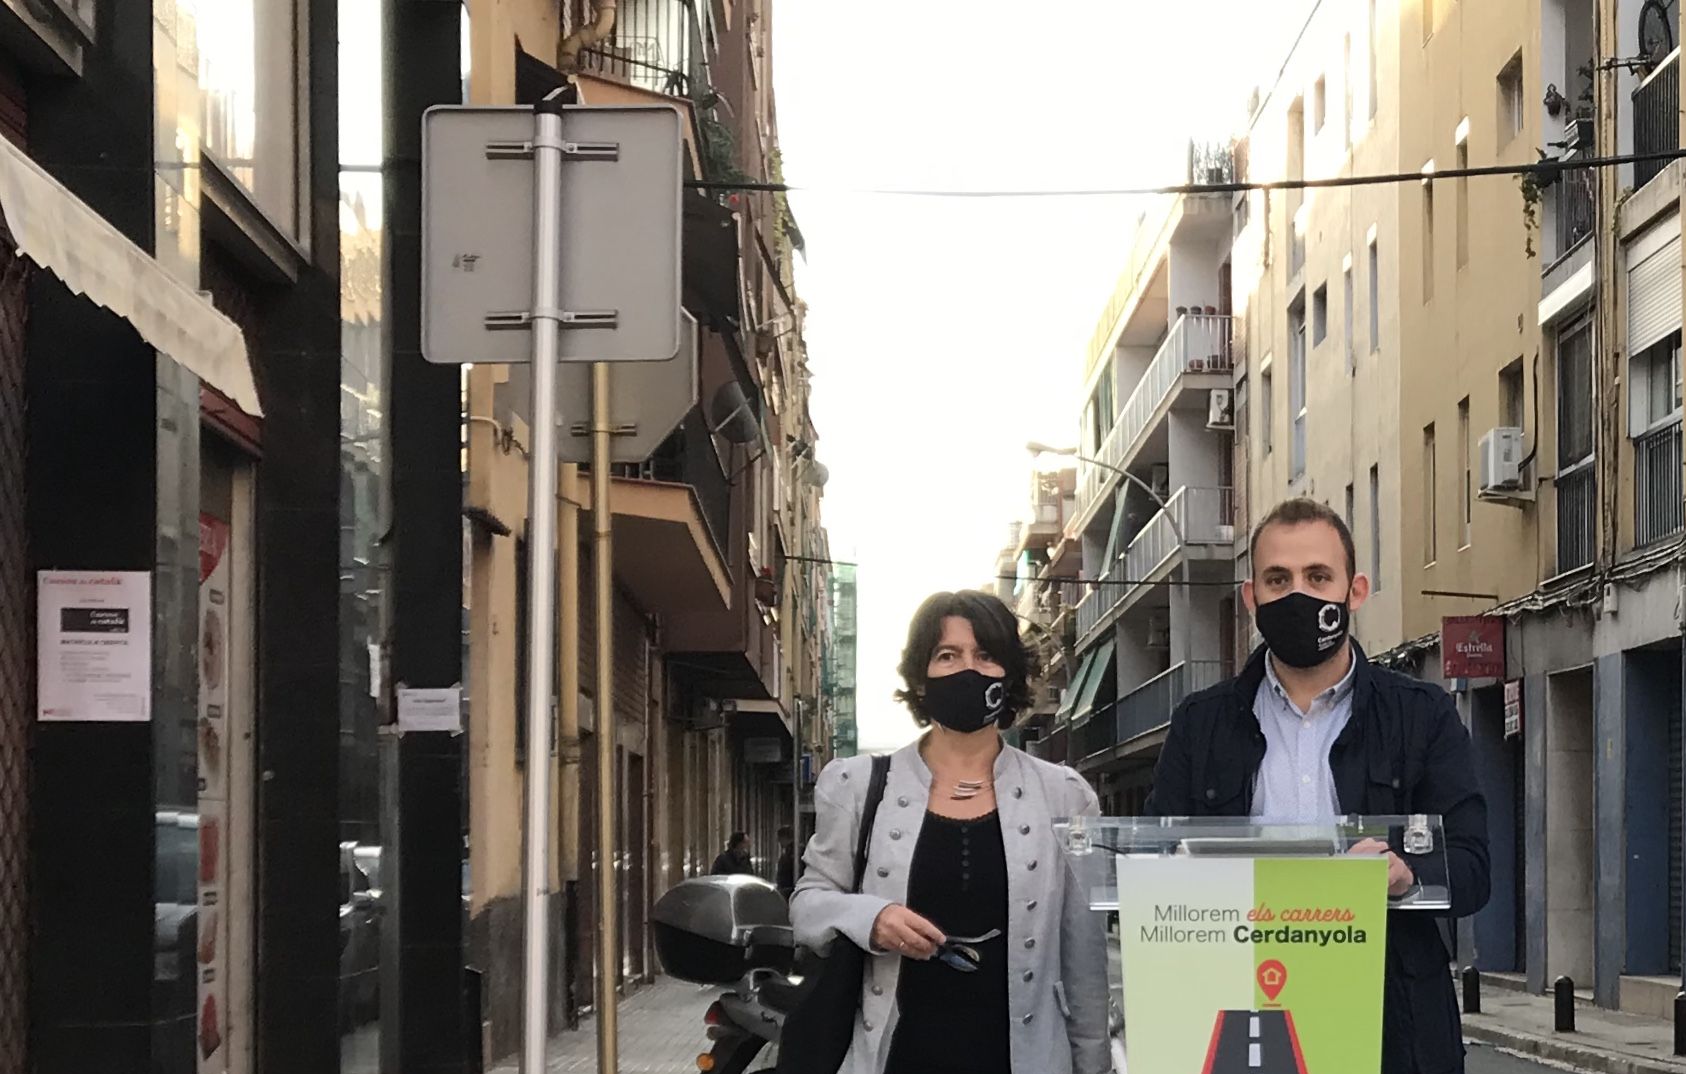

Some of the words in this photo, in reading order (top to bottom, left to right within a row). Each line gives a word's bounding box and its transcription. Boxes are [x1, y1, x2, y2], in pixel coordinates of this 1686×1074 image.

[1455, 641, 1493, 653] Estrella
[1154, 904, 1240, 922] Millorem
[1247, 902, 1276, 922] els
[1280, 907, 1356, 922] carrers
[1140, 925, 1226, 943] Millorem
[1233, 925, 1367, 947] Cerdanyola
